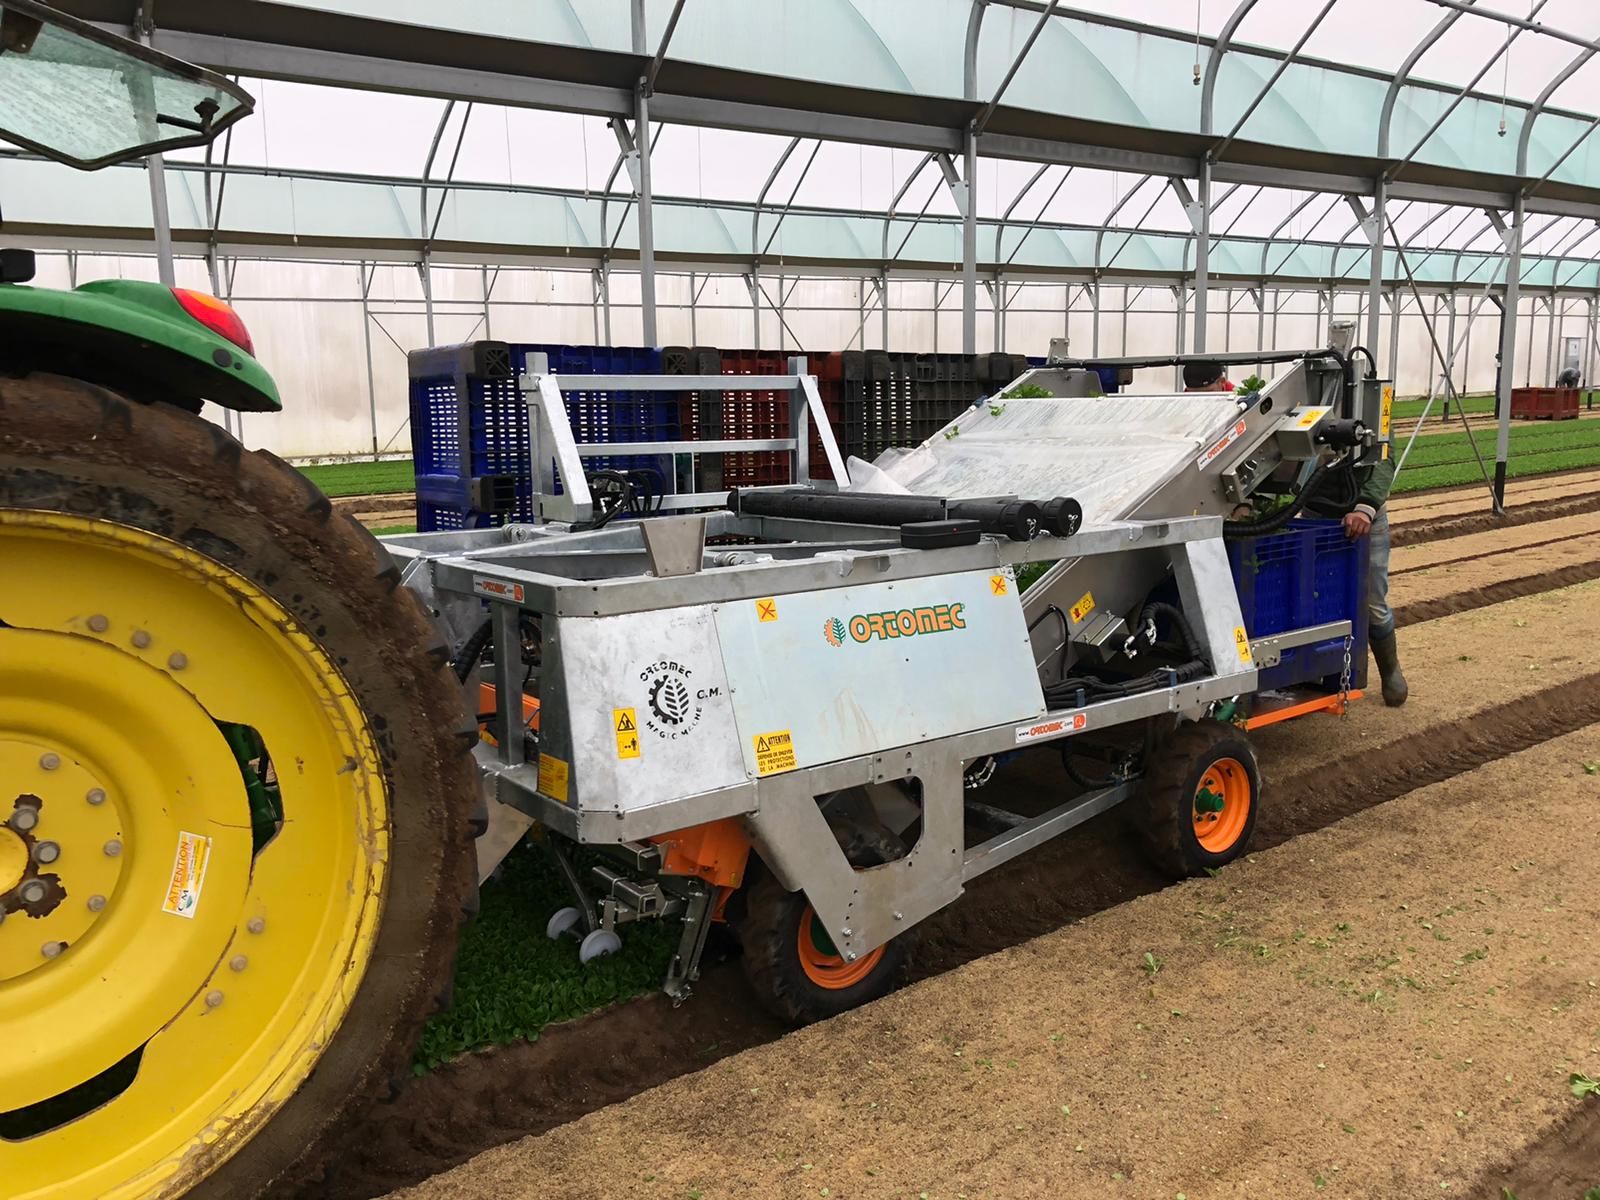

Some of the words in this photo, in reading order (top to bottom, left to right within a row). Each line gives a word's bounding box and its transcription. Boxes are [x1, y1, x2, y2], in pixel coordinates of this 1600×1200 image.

[849, 603, 966, 643] ORTOMEC
[639, 660, 692, 682] ORTOMEC
[696, 687, 722, 700] C.M.
[768, 733, 791, 746] ATTENTION
[168, 840, 189, 904] ATTENTION
